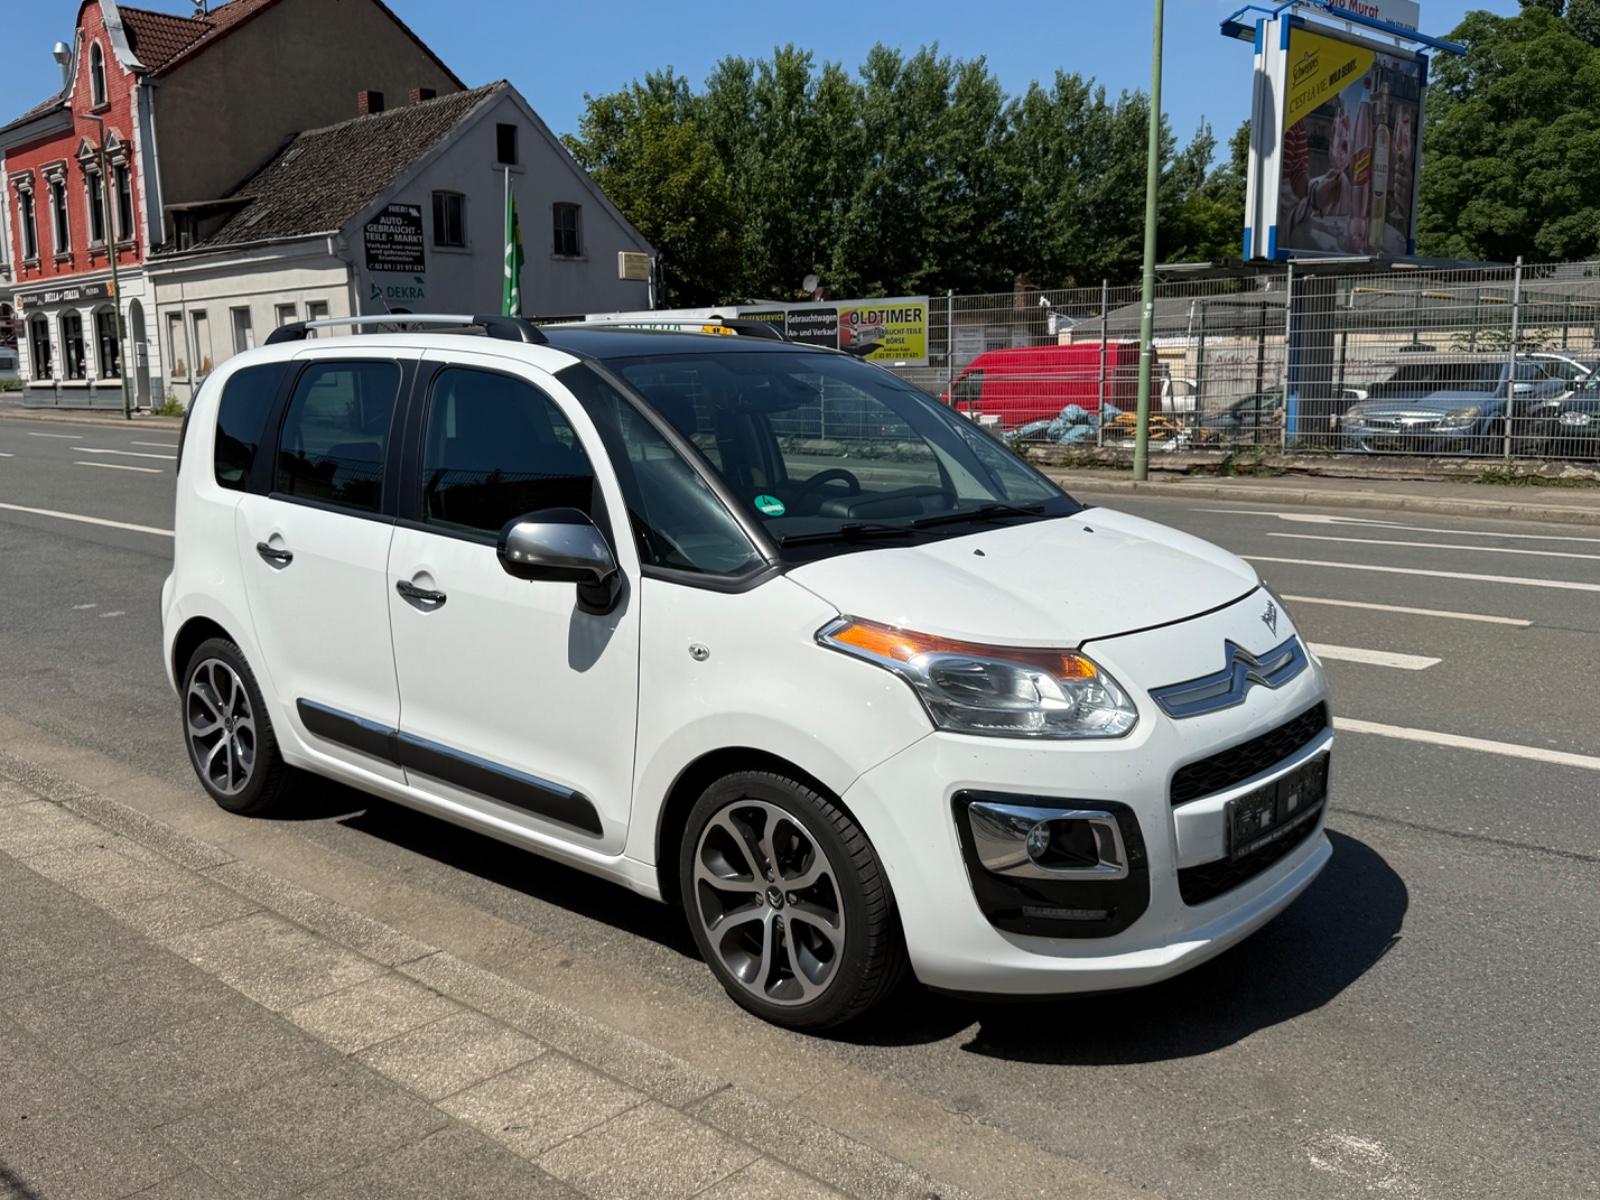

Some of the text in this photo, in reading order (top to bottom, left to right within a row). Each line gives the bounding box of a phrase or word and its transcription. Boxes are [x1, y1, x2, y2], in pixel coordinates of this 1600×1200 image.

[380, 216, 402, 225] AUTO
[367, 224, 415, 234] GEBRAUCHT
[365, 232, 387, 242] TEILE
[394, 233, 423, 243] MARKT
[387, 286, 425, 298] DEKRA
[787, 314, 837, 324] Gebrauchtwagen
[850, 308, 922, 324] OLDTIMER
[799, 328, 812, 336] und
[812, 327, 837, 336] Verkauf
